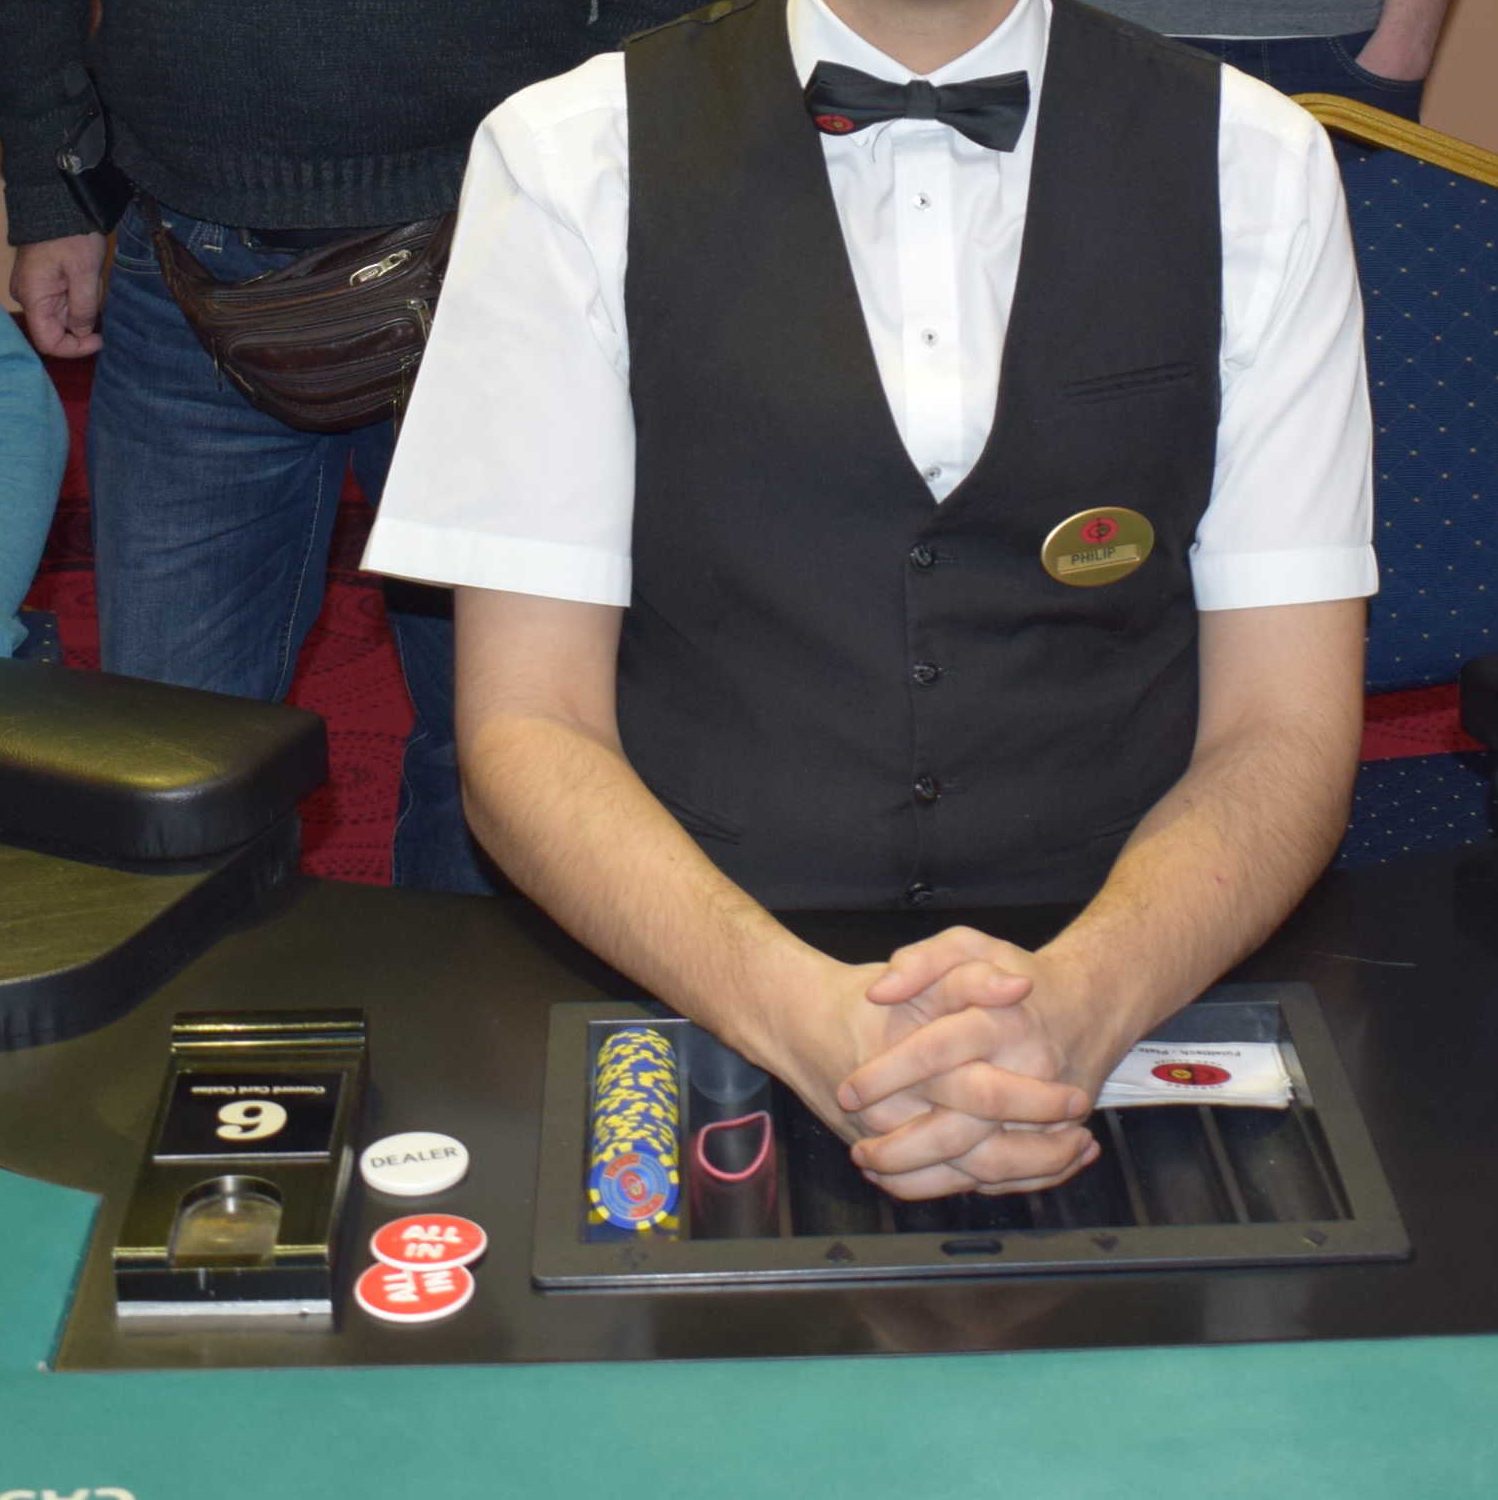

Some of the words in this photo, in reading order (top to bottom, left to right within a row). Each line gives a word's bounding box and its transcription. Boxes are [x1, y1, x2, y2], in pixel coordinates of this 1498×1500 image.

[370, 1147, 459, 1169] DEALER
[402, 1225, 462, 1244] ALL
[404, 1243, 446, 1259] IN
